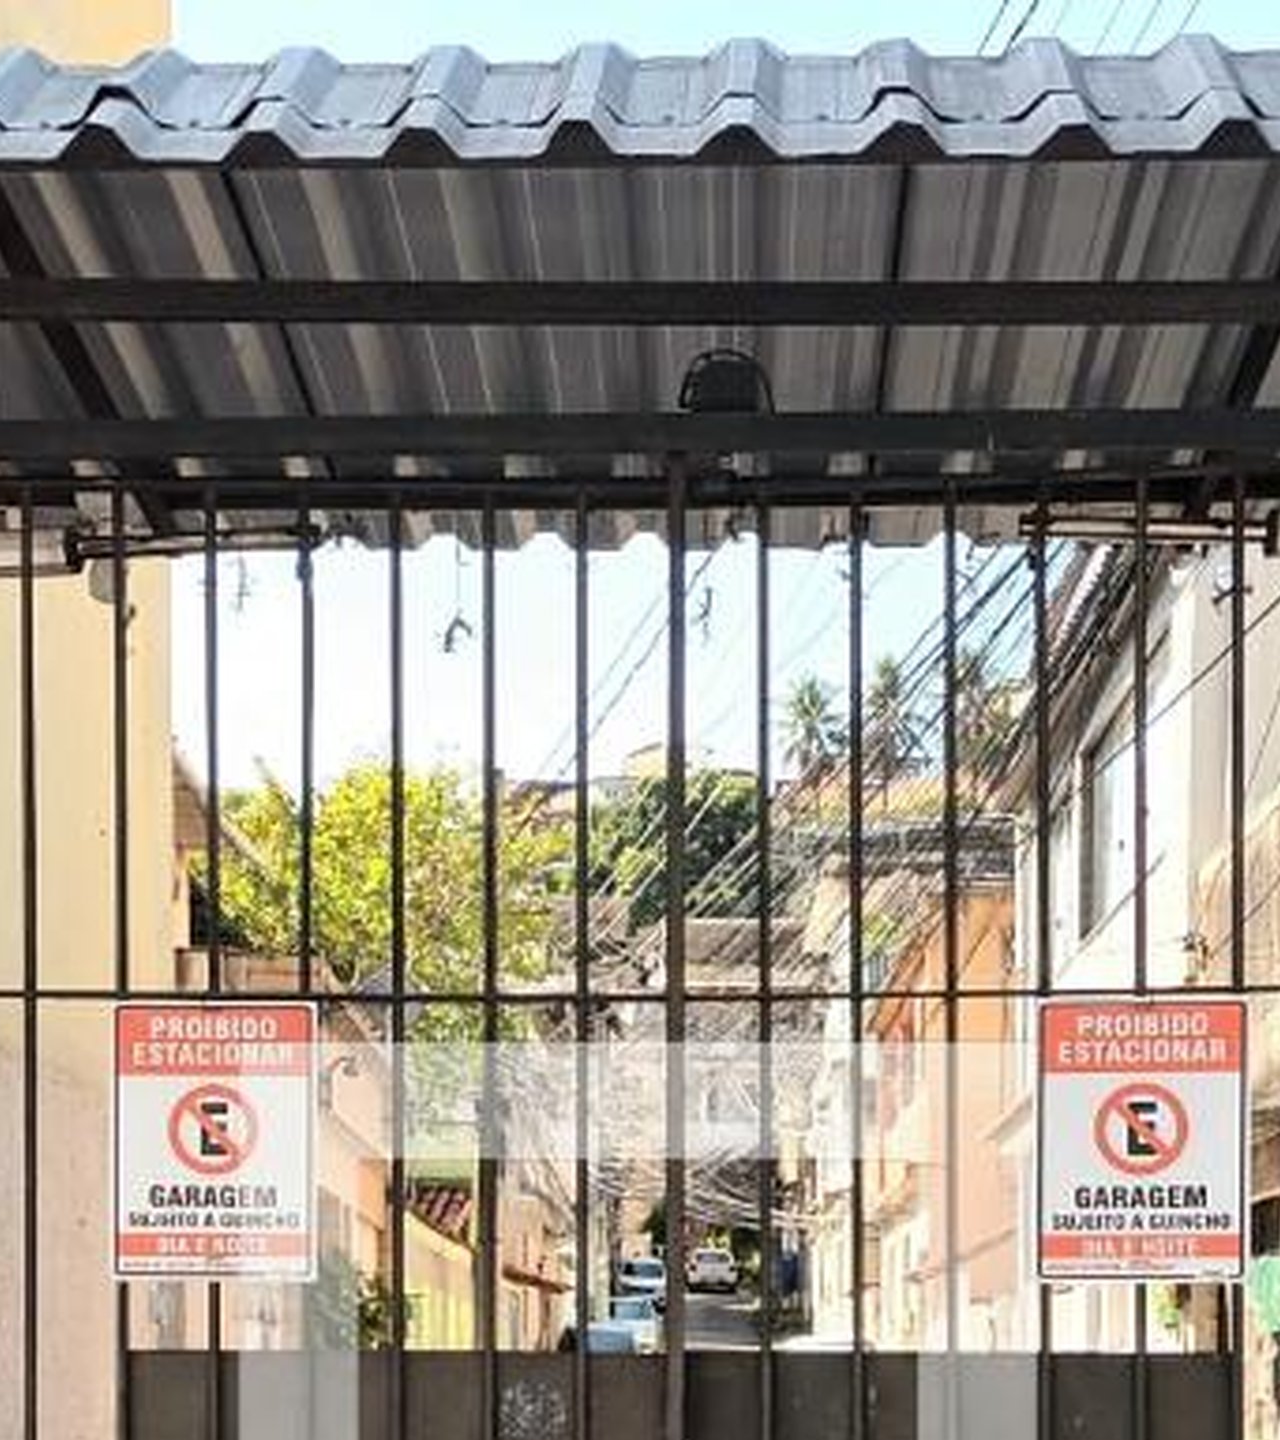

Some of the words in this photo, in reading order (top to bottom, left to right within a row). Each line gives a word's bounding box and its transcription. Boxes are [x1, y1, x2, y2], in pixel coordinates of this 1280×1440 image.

[150, 1016, 278, 1040] PROIBIDO
[1076, 1011, 1209, 1037] PROIBIDO
[132, 1041, 294, 1066] ESTACIONAR
[1058, 1038, 1227, 1063] ESTACIONAR
[148, 1184, 278, 1209] GARAGEM
[1074, 1185, 1209, 1209] GARAGEM
[203, 1211, 217, 1228] A
[1052, 1214, 1125, 1230] SUJEITO
[1130, 1213, 1144, 1230] A
[1149, 1213, 1231, 1231] GUINCHO
